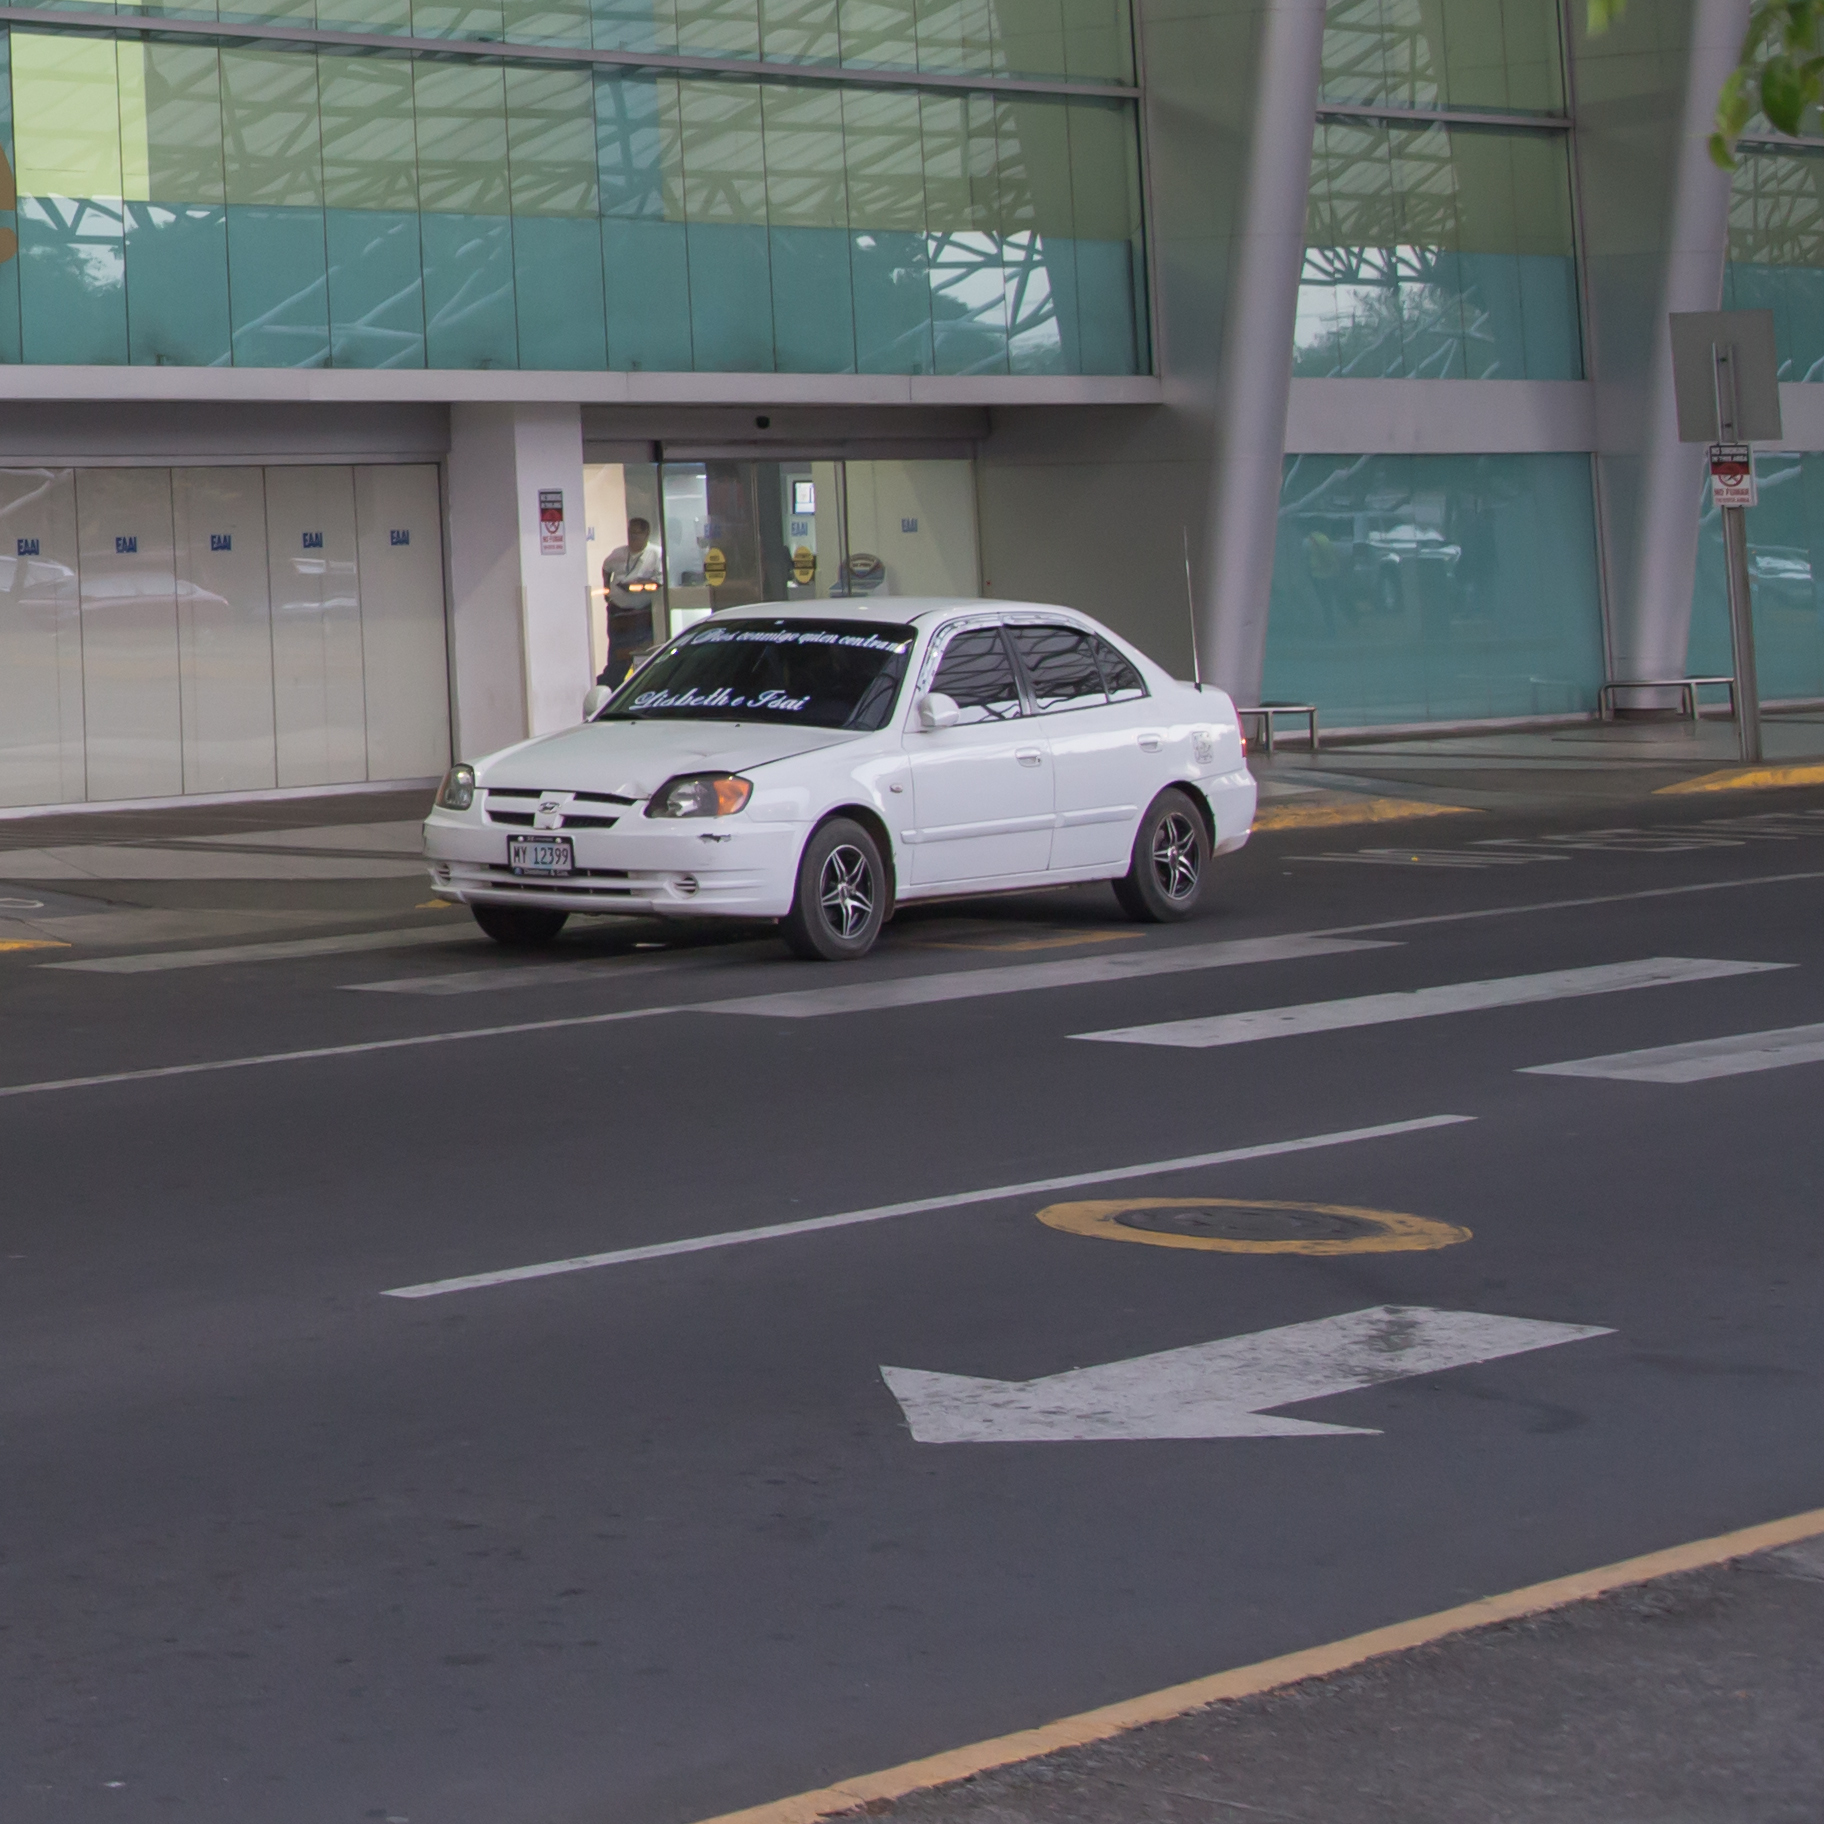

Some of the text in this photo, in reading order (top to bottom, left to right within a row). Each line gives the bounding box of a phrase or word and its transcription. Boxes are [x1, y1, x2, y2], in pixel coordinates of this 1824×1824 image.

[115, 536, 137, 554] EAAI
[210, 534, 232, 552] EAAI
[302, 532, 324, 549] EAAI
[390, 529, 410, 546] EAAI
[17, 539, 40, 556] EAAI
[514, 845, 569, 865] MY 12399
